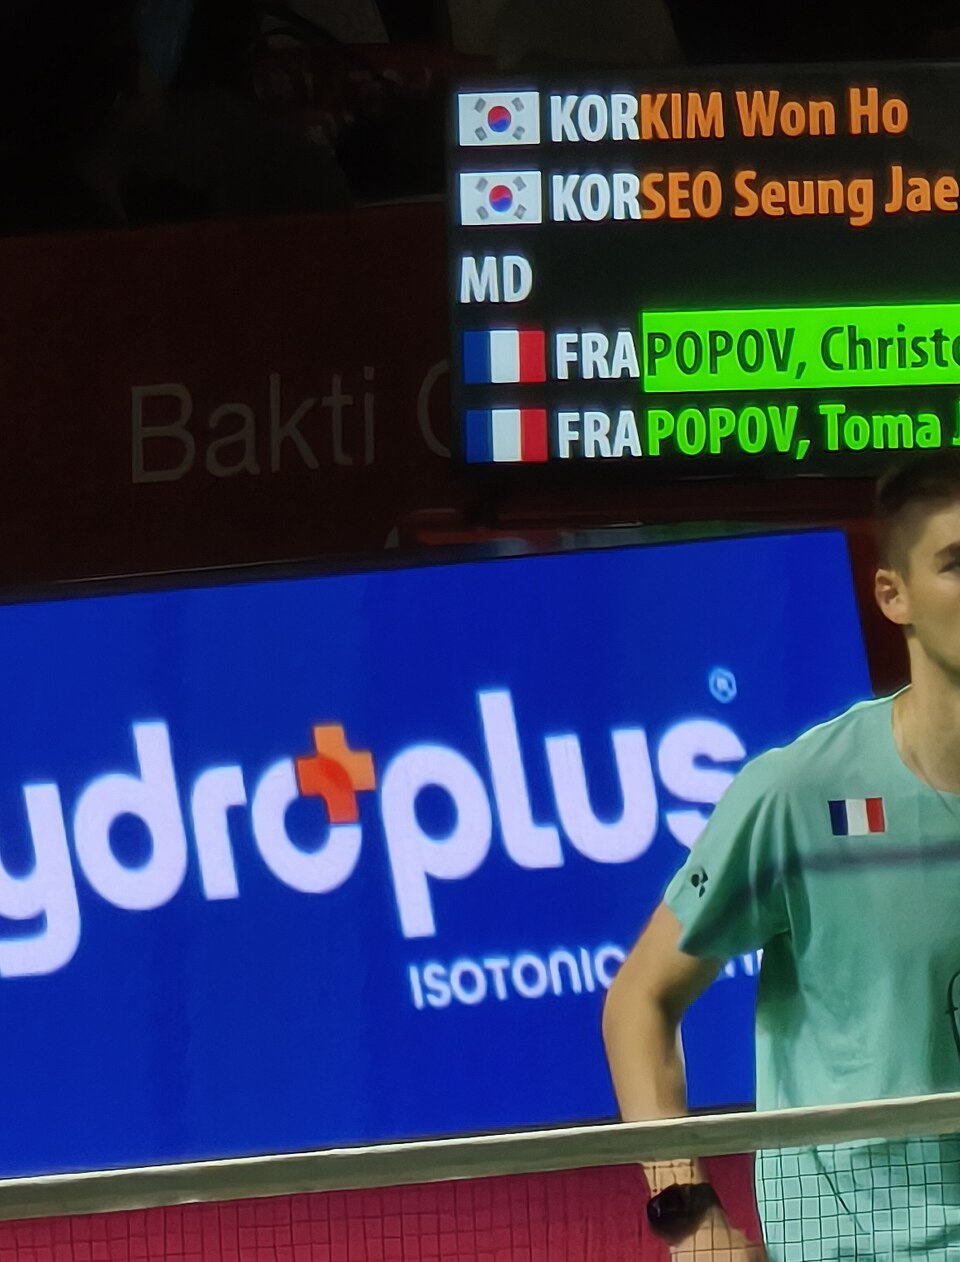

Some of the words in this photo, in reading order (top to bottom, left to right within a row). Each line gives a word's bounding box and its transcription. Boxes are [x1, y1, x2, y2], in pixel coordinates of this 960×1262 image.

[550, 93, 640, 143] KOR
[640, 91, 725, 140] KIM
[735, 88, 836, 138] Won
[849, 87, 909, 136] Ho
[552, 172, 641, 222] KOR
[640, 170, 723, 219] SEO
[734, 169, 874, 227] Seung
[884, 165, 960, 214] Jae
[460, 254, 533, 304] MD
[556, 331, 640, 380] FRA
[647, 328, 807, 379] POPOV,
[131, 366, 375, 484] Bakti
[557, 409, 642, 459] FRA
[647, 404, 811, 460] POPOV,
[818, 403, 942, 451] Toma
[408, 945, 626, 1010] ISOTONIC
